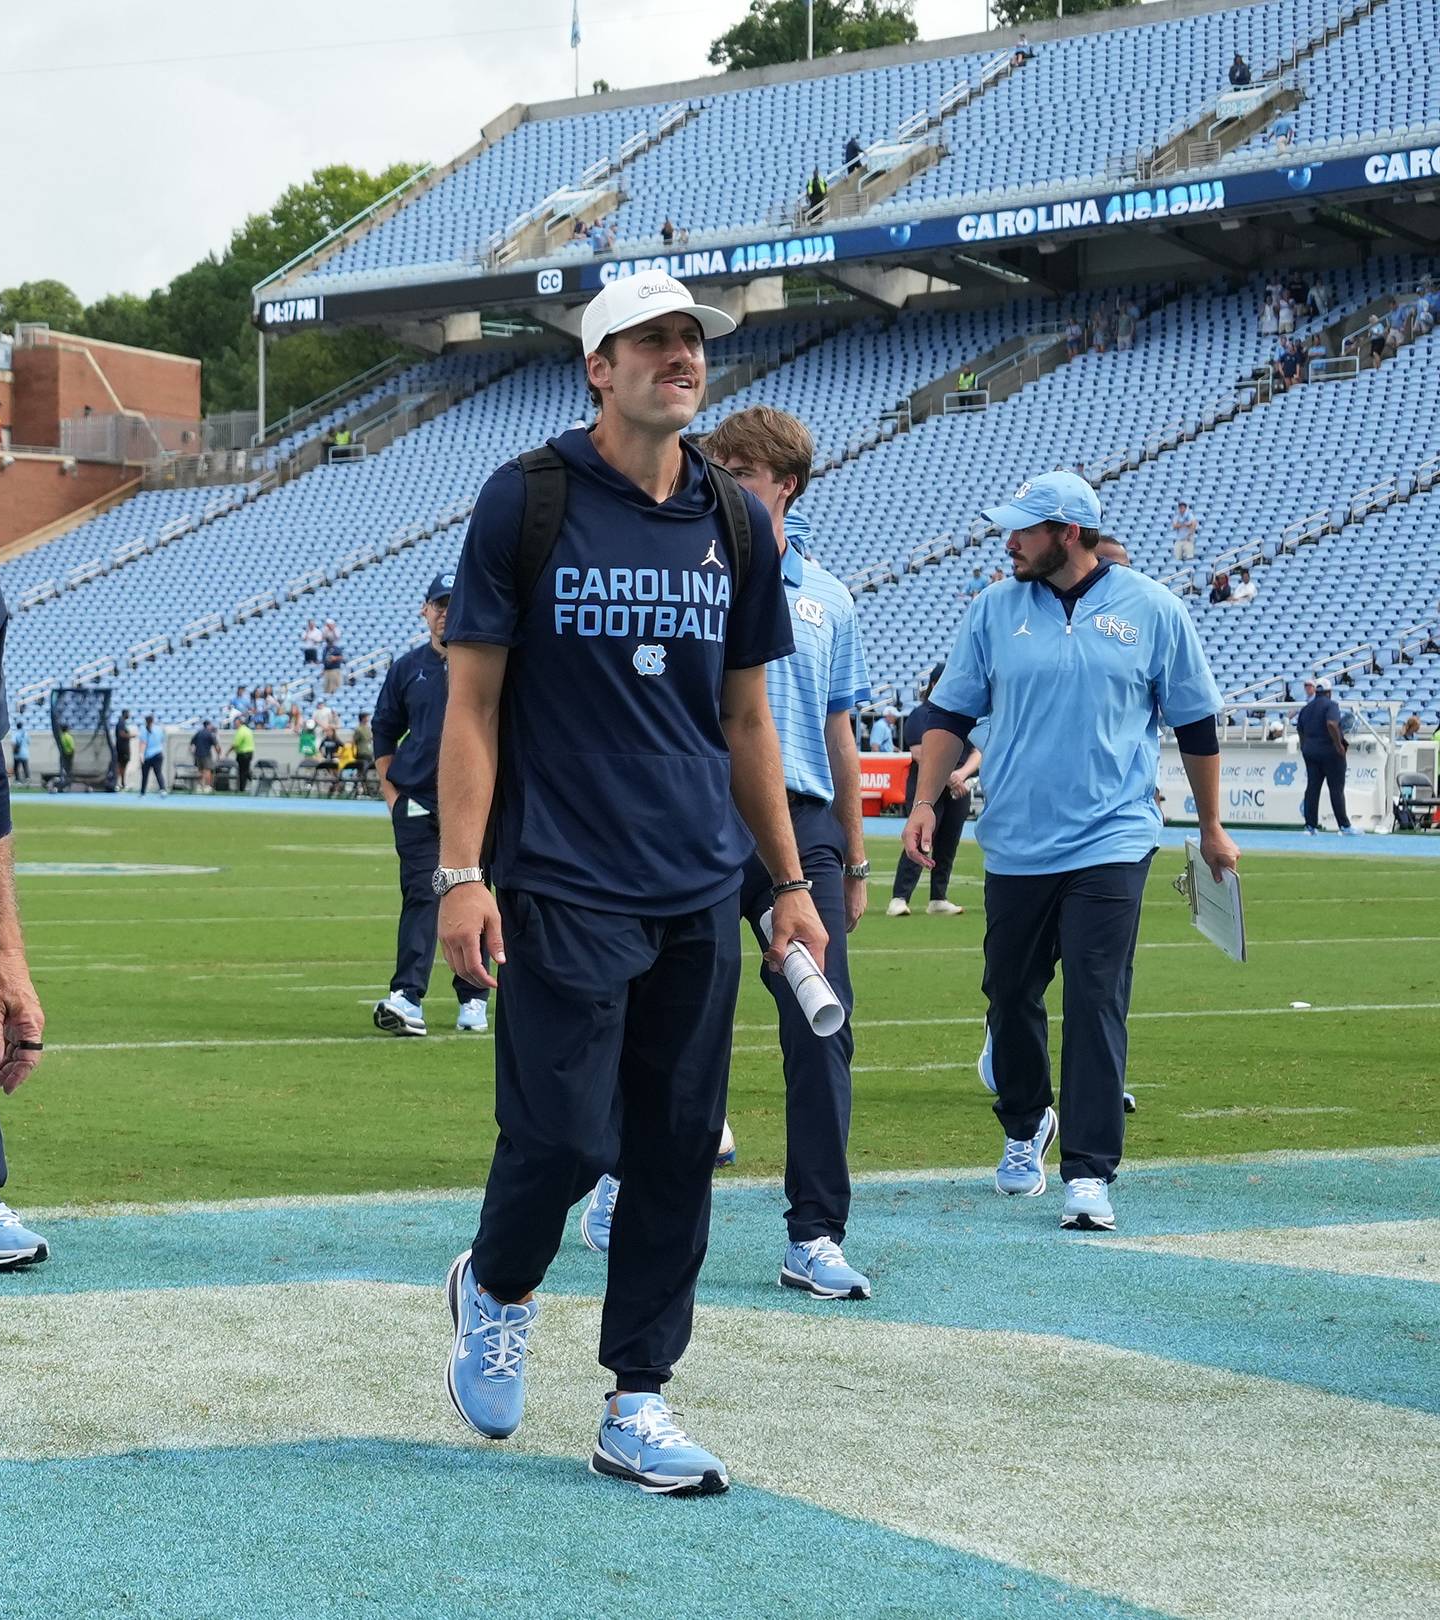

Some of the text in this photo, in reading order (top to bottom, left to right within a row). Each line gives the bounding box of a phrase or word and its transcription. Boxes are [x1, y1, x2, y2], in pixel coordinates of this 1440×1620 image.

[957, 199, 1101, 242] CAROLINA
[599, 250, 728, 286] CAROLINA
[540, 274, 561, 290] CC
[296, 298, 316, 321] PM
[555, 566, 730, 609] CAROLINA
[1093, 614, 1139, 645] UNC
[1229, 789, 1265, 807] UNC
[1229, 810, 1265, 820] HEALTH
